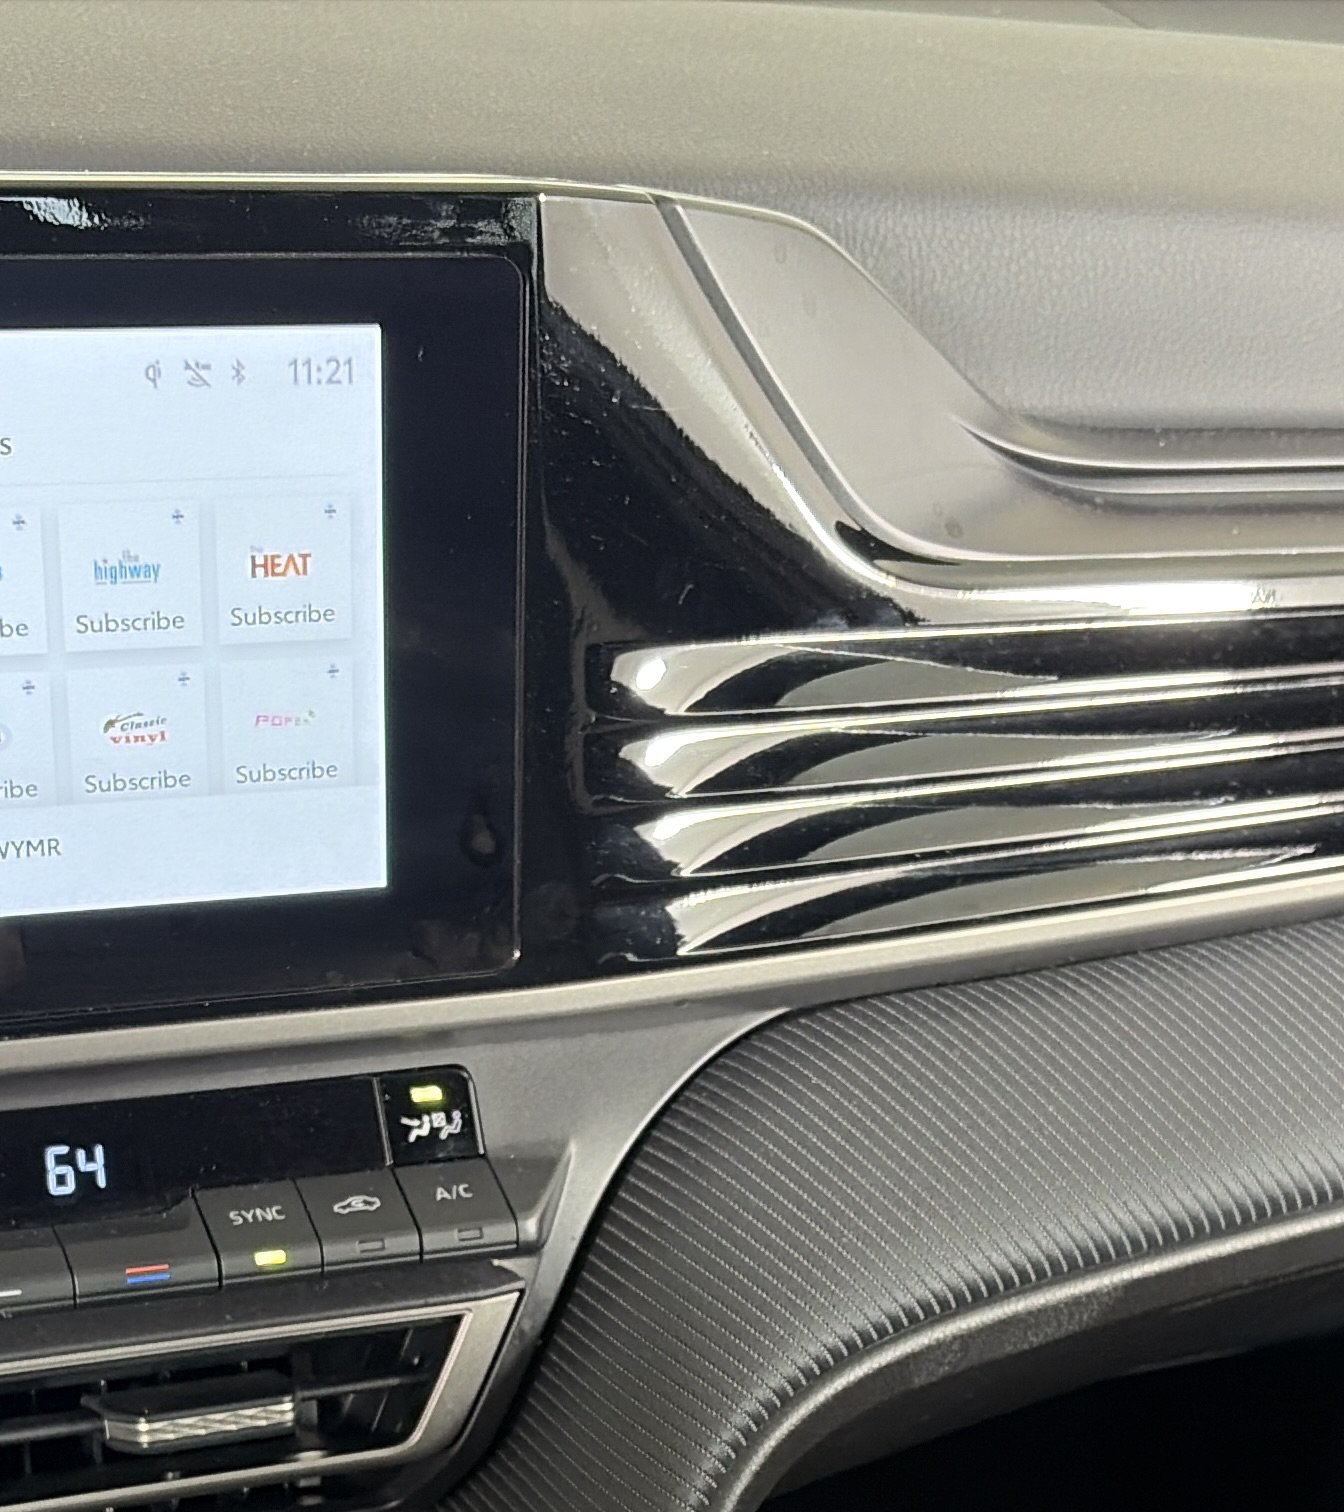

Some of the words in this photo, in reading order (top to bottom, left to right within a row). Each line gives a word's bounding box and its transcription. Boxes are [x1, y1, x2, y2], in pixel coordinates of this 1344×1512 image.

[287, 356, 355, 386] 11:21
[93, 558, 161, 585] highway
[250, 552, 312, 578] HEAT
[75, 609, 186, 636] Subscribe
[231, 602, 336, 627] Subscribe
[83, 769, 192, 795] Subscribe
[236, 760, 339, 784] Subscribe
[43, 1143, 107, 1196] 64
[435, 1183, 474, 1202] A/C
[228, 1204, 286, 1227] SYNC
